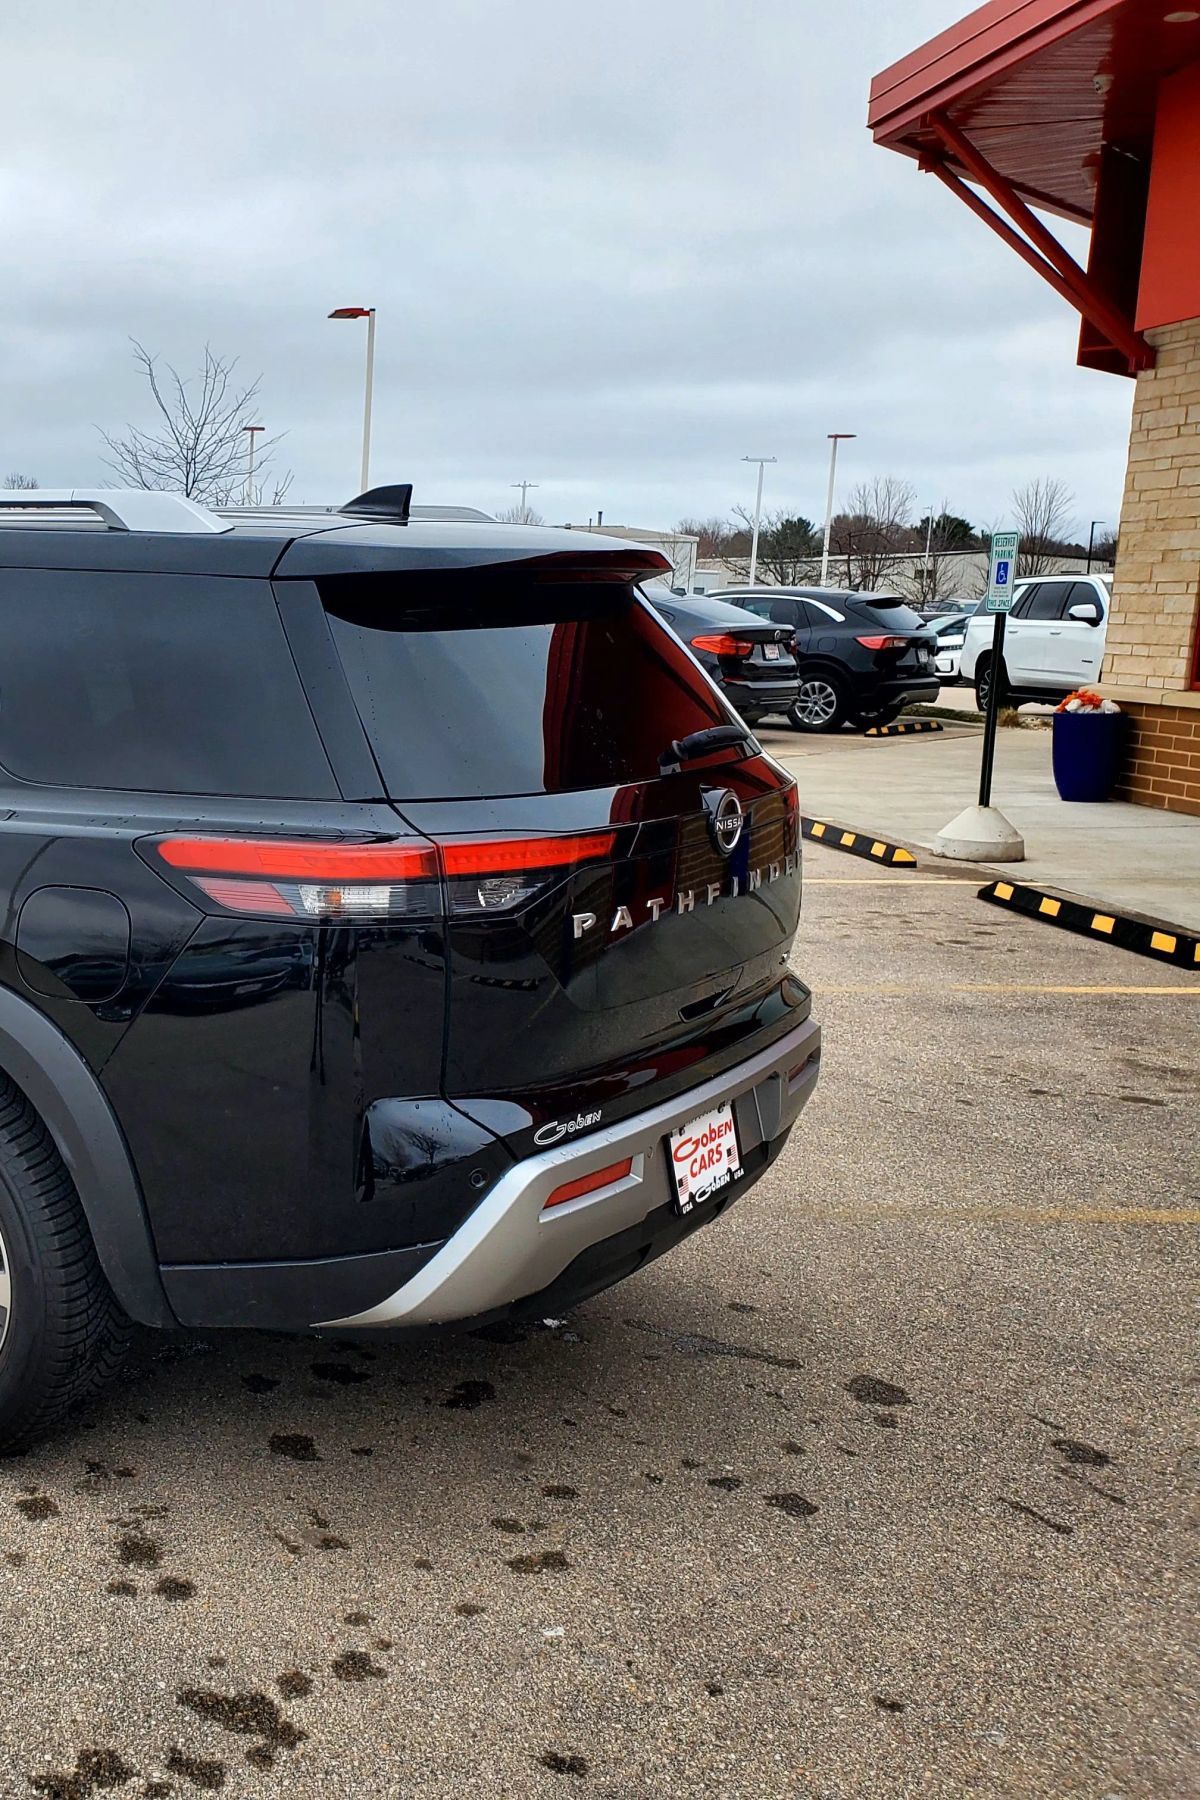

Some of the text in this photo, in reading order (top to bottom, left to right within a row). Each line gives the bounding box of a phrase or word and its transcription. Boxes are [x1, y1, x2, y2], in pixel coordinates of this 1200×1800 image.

[995, 536, 1015, 547] RESERVED
[994, 549, 1013, 559] PARKING
[716, 815, 744, 831] NISSA
[572, 849, 800, 939] PATHFINDE
[690, 1143, 723, 1178] CARS
[734, 1168, 745, 1180] USA
[682, 1202, 694, 1215] USA
